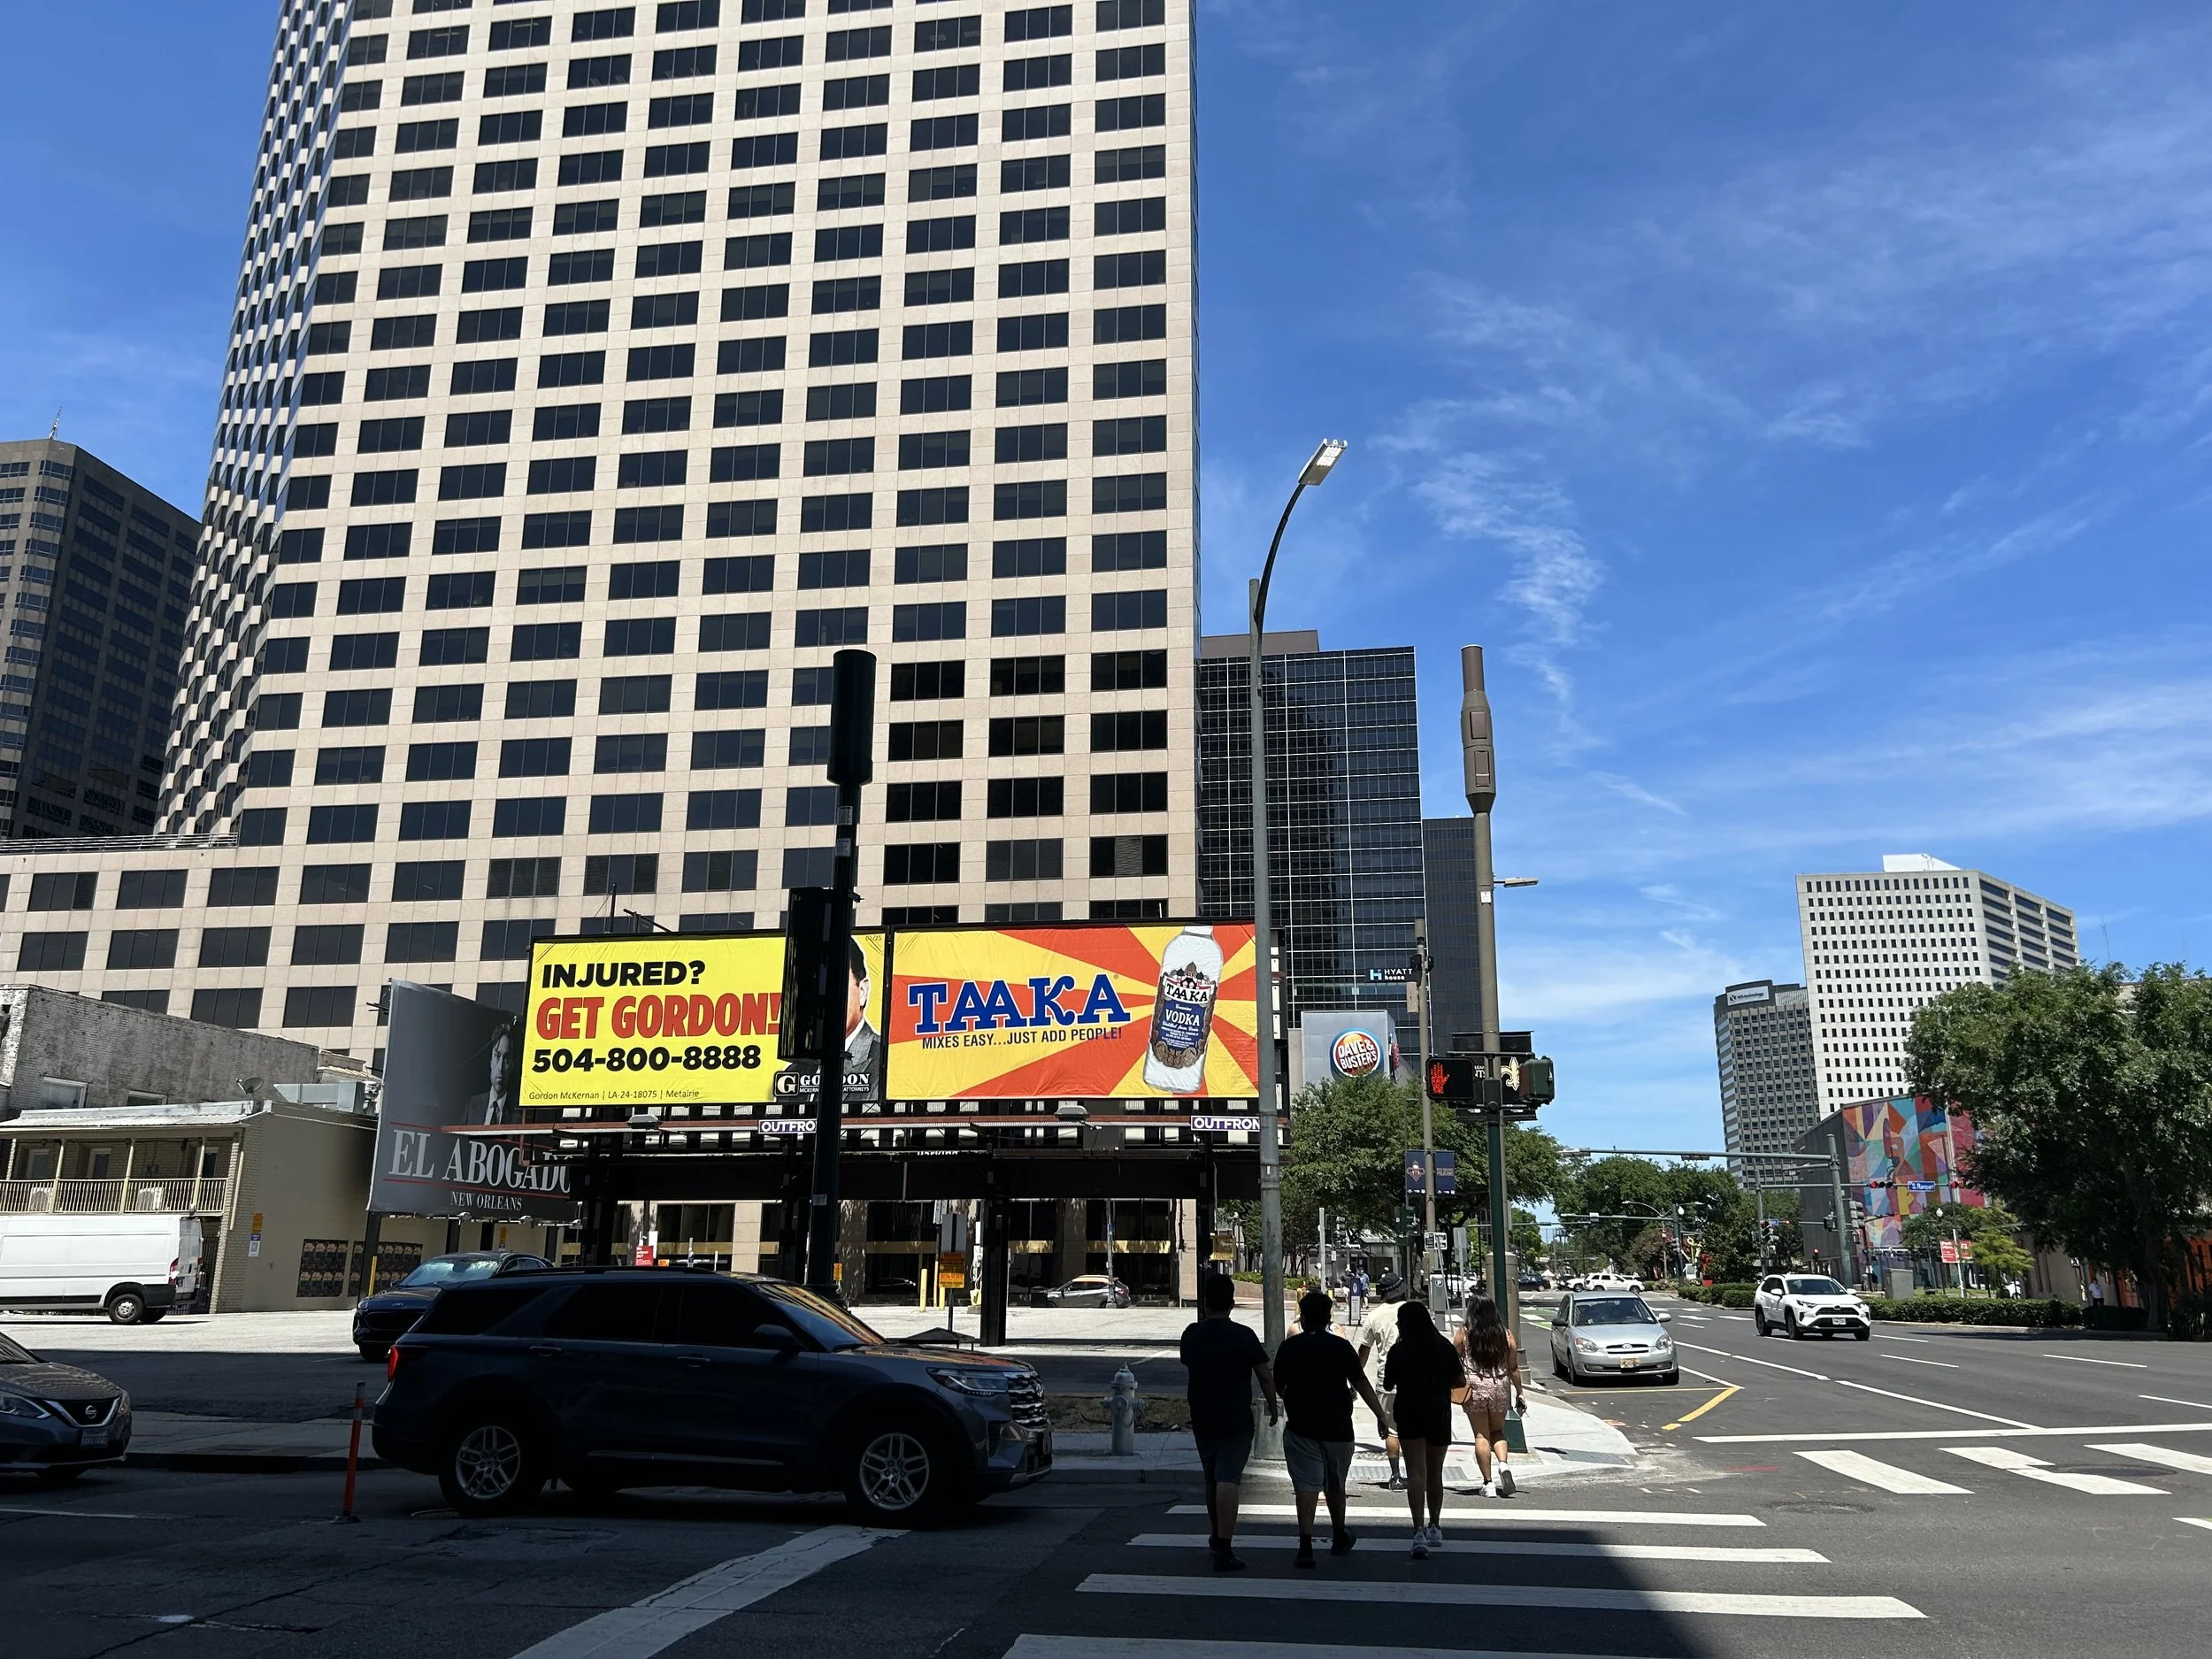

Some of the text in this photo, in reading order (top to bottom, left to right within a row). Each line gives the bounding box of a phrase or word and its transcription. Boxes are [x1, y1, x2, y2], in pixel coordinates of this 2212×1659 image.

[541, 960, 706, 988] INJURED?
[1166, 983, 1209, 1002] TAAKA
[908, 972, 1131, 1034] TAAKA
[536, 993, 782, 1040] GET GORDON!
[1165, 1009, 1201, 1026] VODKA
[922, 1034, 959, 1049] MIXES
[1041, 1029, 1067, 1042] ADD
[1071, 1026, 1122, 1041] PEOPLE!
[532, 1045, 761, 1073] 504-800-8888
[1338, 1041, 1364, 1058] DAVE
[1340, 1050, 1378, 1070] BUSTER'S
[800, 1073, 870, 1086] GOON
[560, 1091, 600, 1100] McKernan
[608, 1090, 657, 1099] LA-24-18075
[665, 1089, 700, 1098] Metairie
[761, 1120, 817, 1133] OUTFRO
[1194, 1117, 1260, 1130] OUTFRON
[388, 1129, 435, 1179] EL
[450, 1191, 522, 1211] NEW ORLEANS
